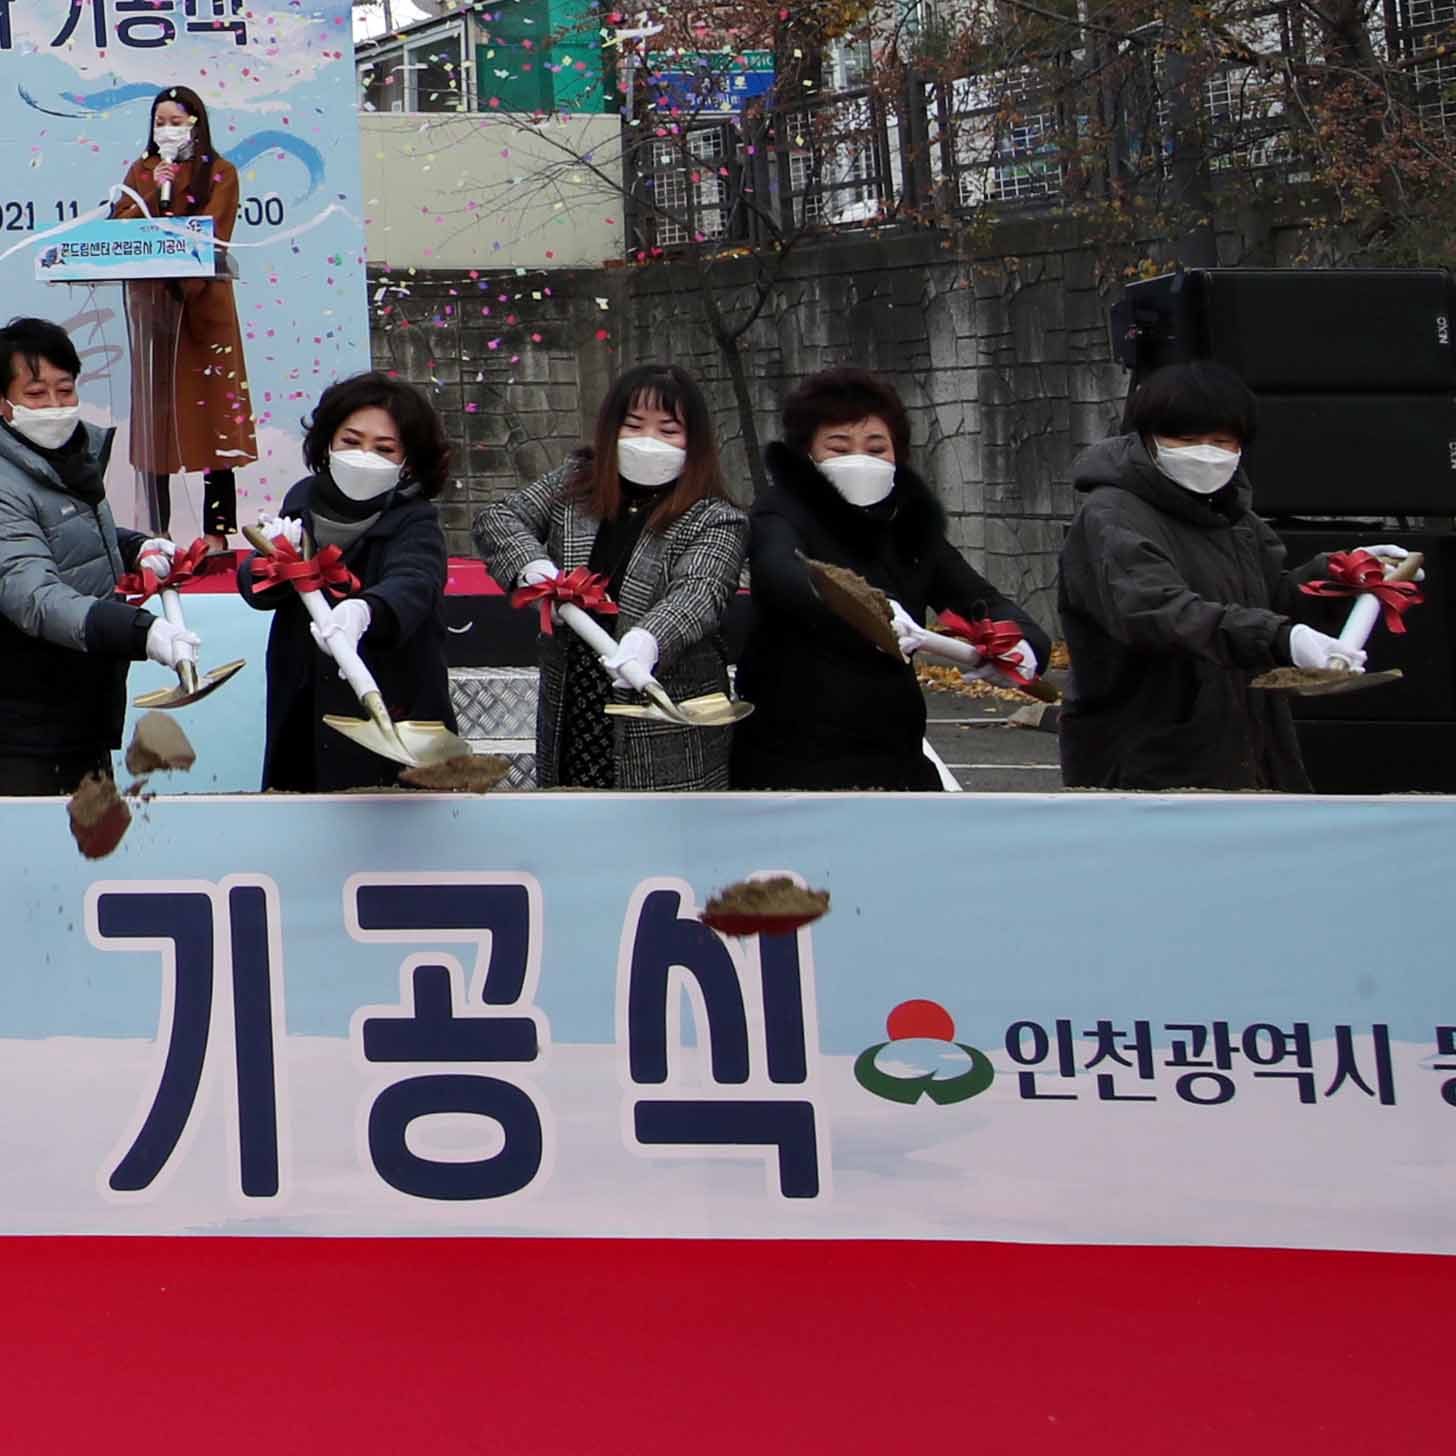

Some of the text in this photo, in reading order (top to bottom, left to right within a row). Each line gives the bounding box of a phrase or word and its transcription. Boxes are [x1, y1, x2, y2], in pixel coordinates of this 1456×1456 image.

[60, 239, 186, 257] 꿈드림센터 건립공사 기공식
[96, 879, 821, 1202] 기공식
[1004, 1018, 1395, 1107] 인천광역시
